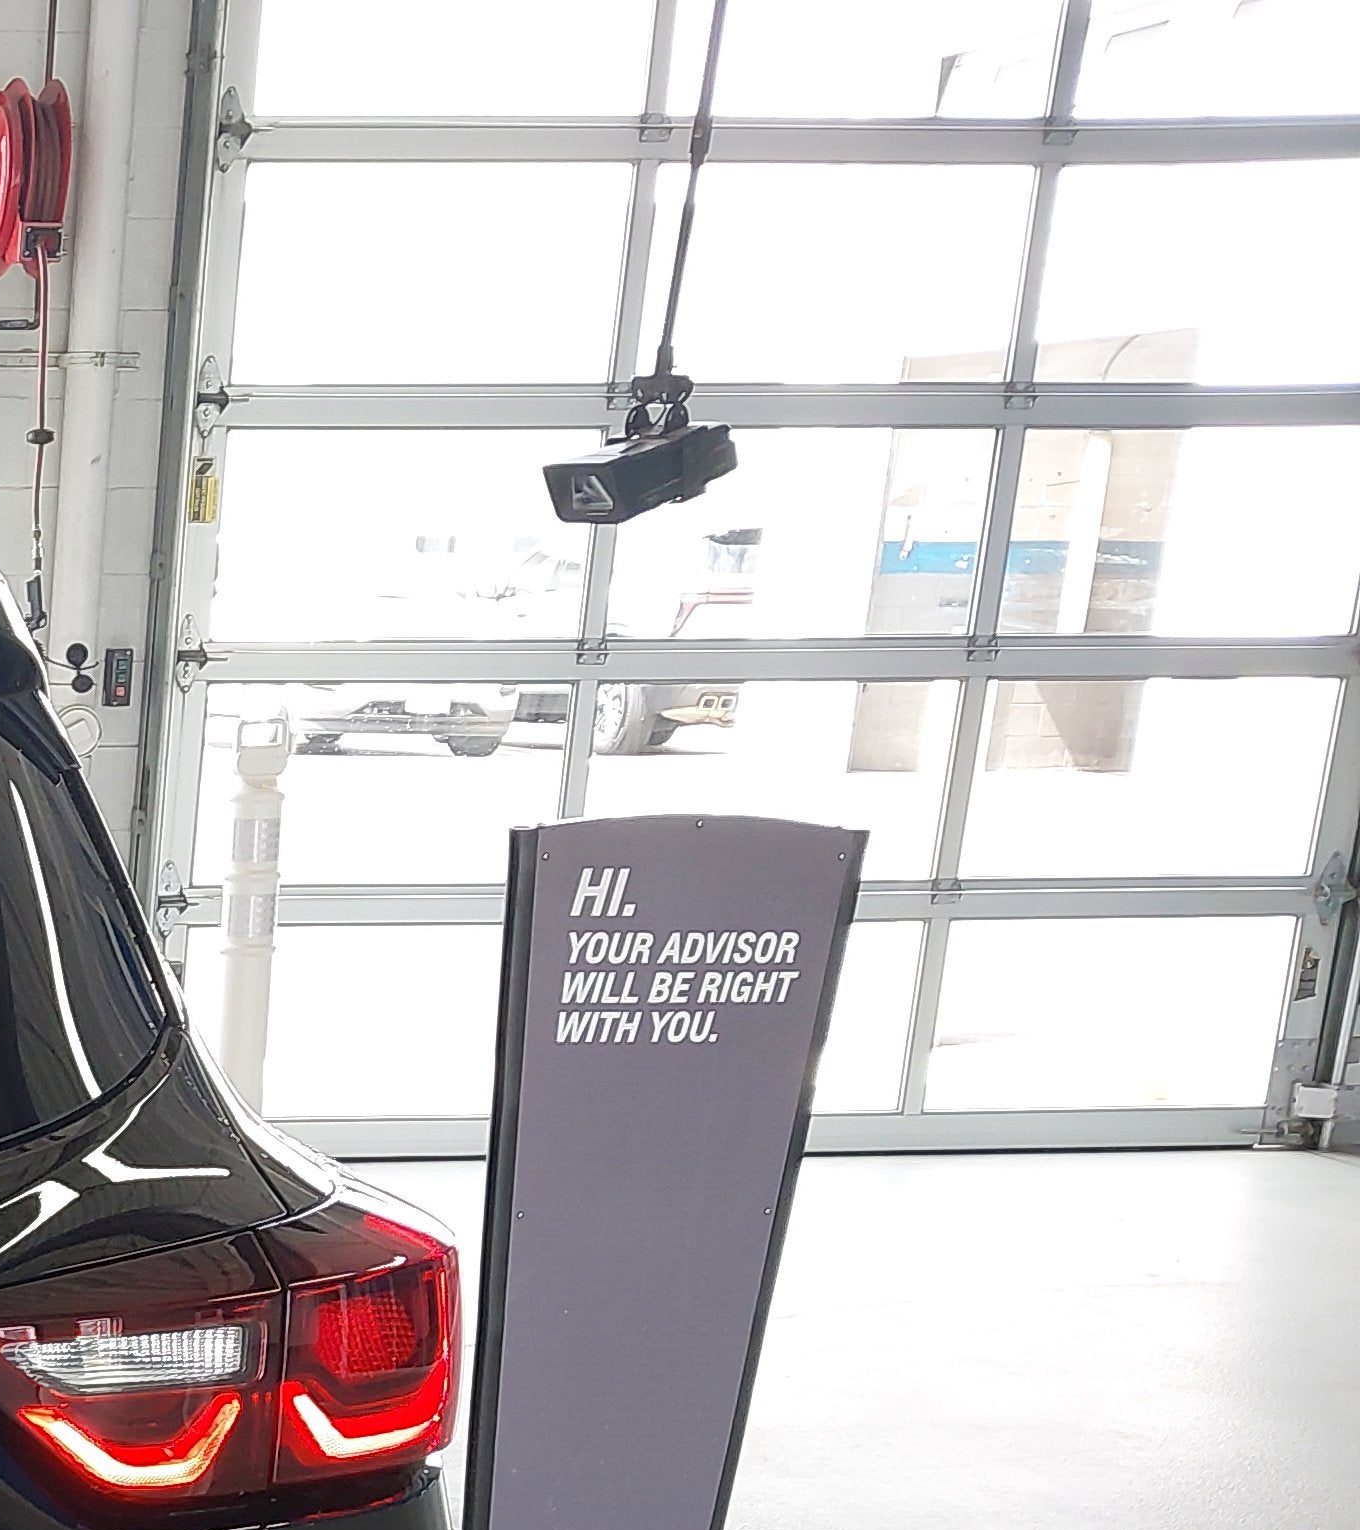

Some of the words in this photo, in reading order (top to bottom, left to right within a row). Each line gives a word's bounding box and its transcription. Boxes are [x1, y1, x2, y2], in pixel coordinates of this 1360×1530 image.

[569, 867, 637, 918] HI.
[568, 931, 654, 965] YOUR
[657, 931, 801, 965] ADVISOR
[561, 971, 641, 1005] WILL
[647, 971, 696, 1004] BE
[697, 970, 800, 1004] RIGHT
[555, 1010, 642, 1044] WITH
[649, 1010, 720, 1044] YOU.
